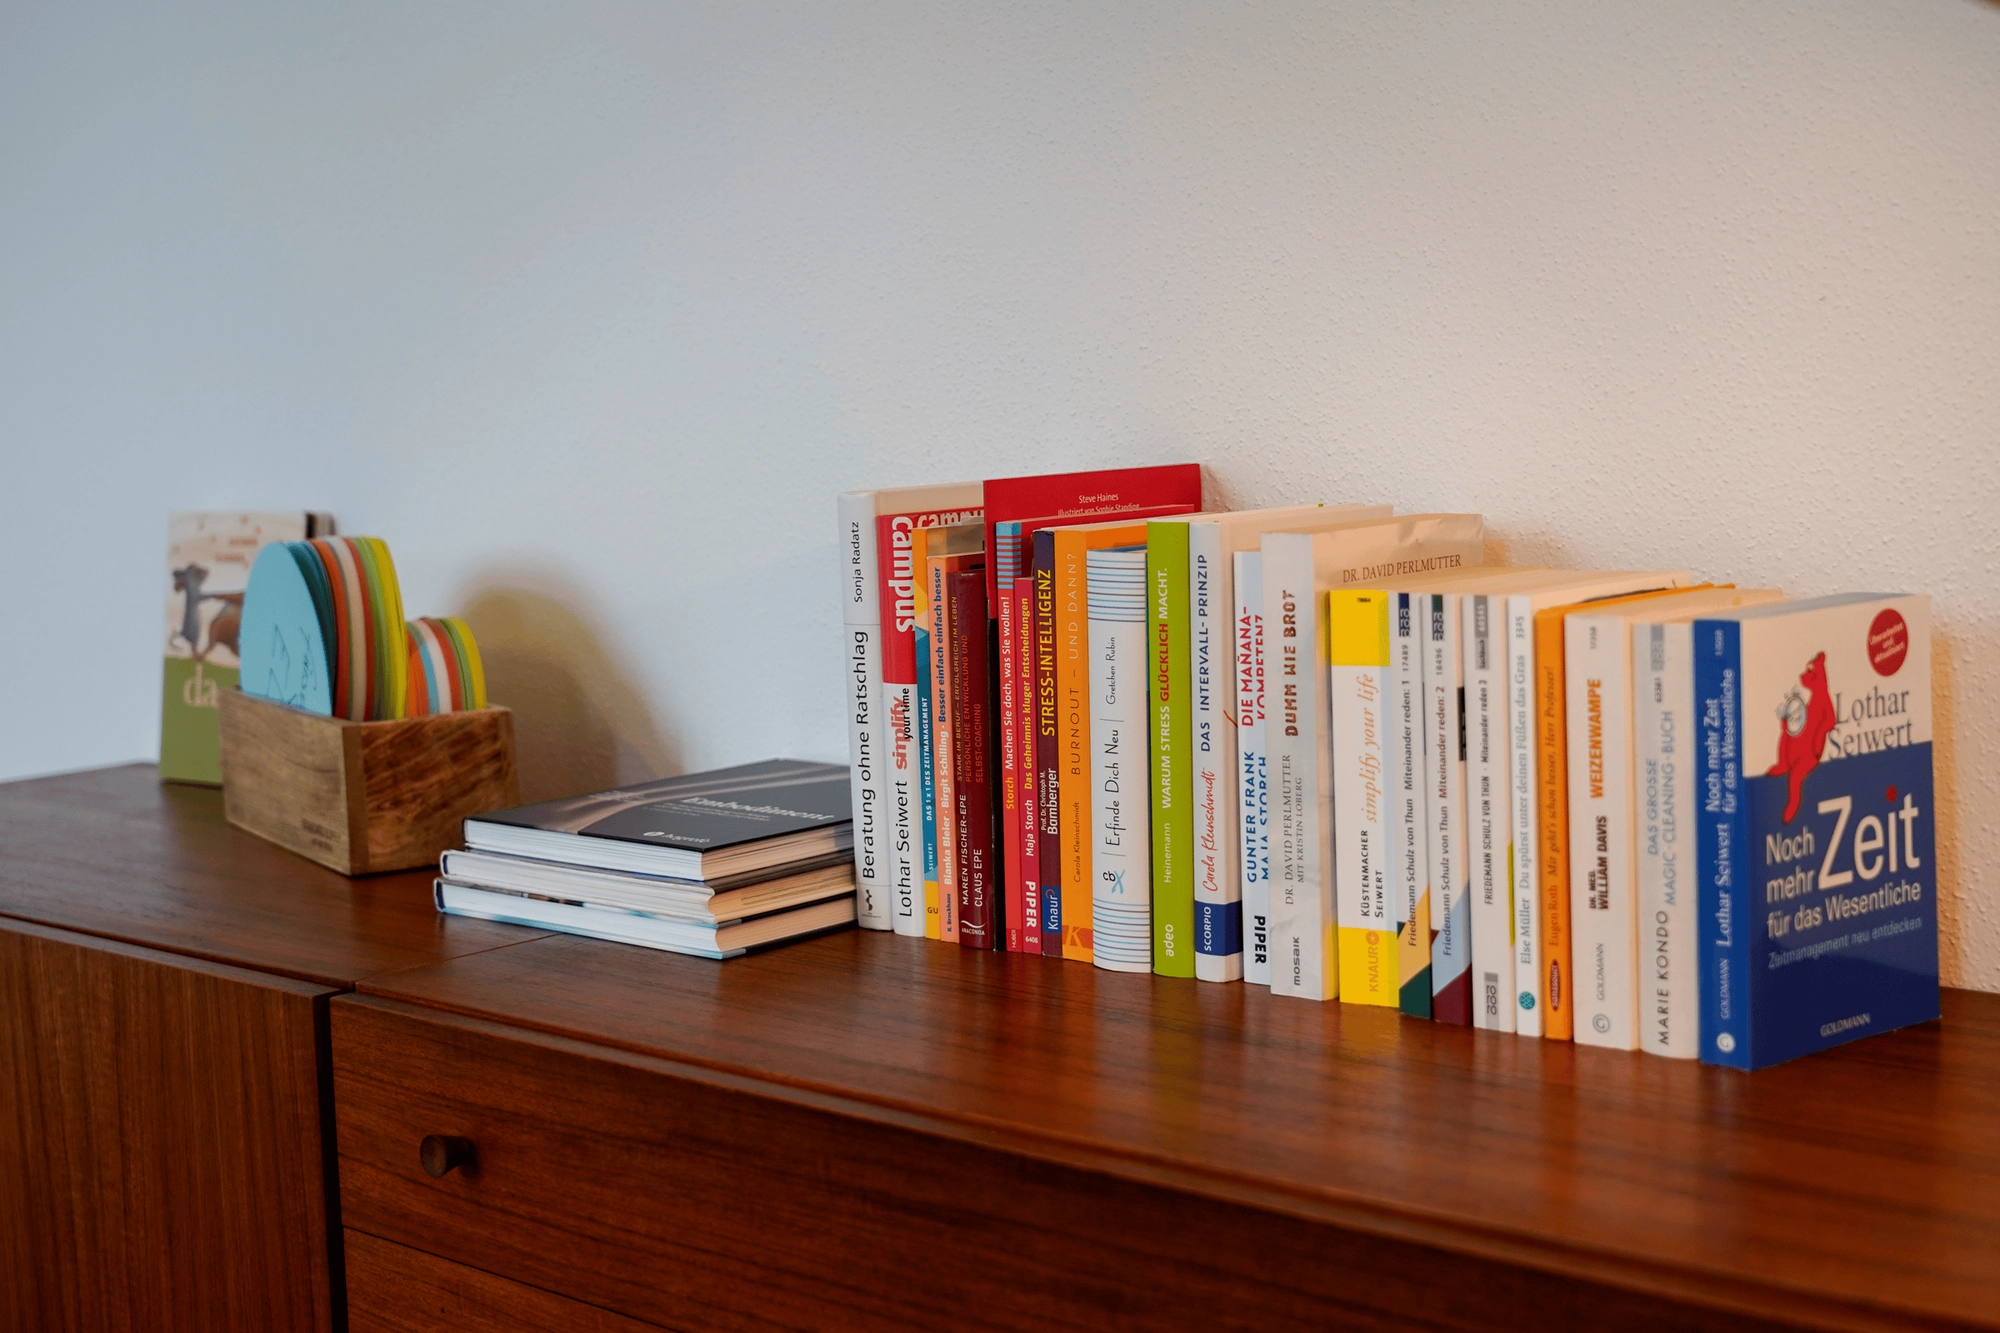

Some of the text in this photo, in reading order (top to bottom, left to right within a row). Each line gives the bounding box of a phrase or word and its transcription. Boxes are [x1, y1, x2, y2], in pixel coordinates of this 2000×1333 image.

[852, 521, 864, 603] Sonja Radatz
[1343, 554, 1461, 583] DR. DAVID PERLMUTTER
[934, 567, 946, 723] Besser einfach einfach besser
[952, 641, 960, 700] ERFOLGREICH
[1037, 570, 1056, 737] STRESS-INTELLIGENZ
[1067, 553, 1081, 775] BURNOUT UND DANN?
[1106, 636, 1116, 705] Gretchen Rubin
[1197, 554, 1210, 752] DAS INTERVALL- PRINZIP
[1237, 606, 1254, 727] DIE MAÑANA-
[1282, 590, 1298, 737] DUMM WIE BROT
[901, 688, 914, 739] your time
[962, 656, 971, 719] ENTWICKLUNG
[1001, 596, 1014, 809] Storch Machen Sie doch, was Sie wollen!
[1157, 568, 1171, 809] WARUM STRESS GLÜCKLICH MACHT.
[1401, 689, 1411, 723] reden:
[1834, 685, 1910, 725] Lothar
[853, 631, 876, 879] Beratung ohne Ratschlag
[890, 696, 911, 770] simplify
[963, 722, 972, 783] PERSÖNLICHE
[974, 704, 983, 783] SELBST-COACHING
[1020, 598, 1035, 856] Maja Storch Das Geheimnis kluger Entscheidungen
[1356, 673, 1381, 823] simplify your life
[1402, 726, 1413, 790] Miteinander
[1587, 679, 1603, 799] WEIZENWAMPE
[1703, 698, 1721, 813] Noch mehr Zeit
[1720, 668, 1736, 814] für das Wesentliche
[1828, 718, 1912, 758] Seiwert
[938, 731, 952, 885] Bianka Bleier Birgit Schilling
[1047, 768, 1059, 835] Bamberger
[1105, 729, 1126, 847] Erfinde Dich Neu
[1243, 752, 1257, 883] GUNTER FRANK
[1404, 798, 1414, 824] Thun
[1436, 696, 1452, 956] Friedemann Schulz von Thun Miteinander reden:
[1478, 687, 1493, 905] FRIEDEMANN SCHULZ VON THUN Miteinander reden
[1514, 655, 1531, 964] Else Müller Du spürst unter deinen Füßen das Gras
[1645, 758, 1658, 856] DAS GROSSE
[895, 781, 912, 917] Lothar Seiwert
[960, 794, 968, 865] FISCHER-EPE
[1072, 802, 1081, 883] Carola Kleinschmidt
[1163, 822, 1172, 883] Heinemann
[1200, 767, 1218, 891] Carola Kleinschmidt
[1282, 753, 1294, 905] DR. DAVID PERLMUTTER
[1296, 824, 1304, 864] KRISTIN
[1405, 849, 1415, 882] Schulz
[1406, 827, 1414, 846] von
[1596, 815, 1609, 909] WILLIAM DAVIS
[1766, 825, 1815, 866] Noch
[1817, 785, 1920, 891] Zeit
[973, 849, 982, 907] CLAUS EPE
[1026, 881, 1037, 928] PIPER
[1296, 866, 1304, 883] MIT
[1360, 829, 1370, 917] KÜSTENMACHER
[1713, 823, 1731, 947] Lothar Seiwert
[1766, 865, 1815, 904] mehr
[1767, 879, 1921, 939] für das Wesentliche
[1048, 895, 1058, 930] Knaur
[1163, 924, 1174, 957] adeo
[1203, 906, 1212, 951] SCORPIO
[1254, 915, 1267, 964] PIPER
[1407, 884, 1417, 947] Friedemann
[1768, 916, 1923, 970] Zeitmanagement neu entdecken
[1368, 945, 1379, 993] KNAUR
[1655, 910, 1669, 1045] MARIE KONDO
[1820, 1012, 1872, 1038] GOLDMANN
